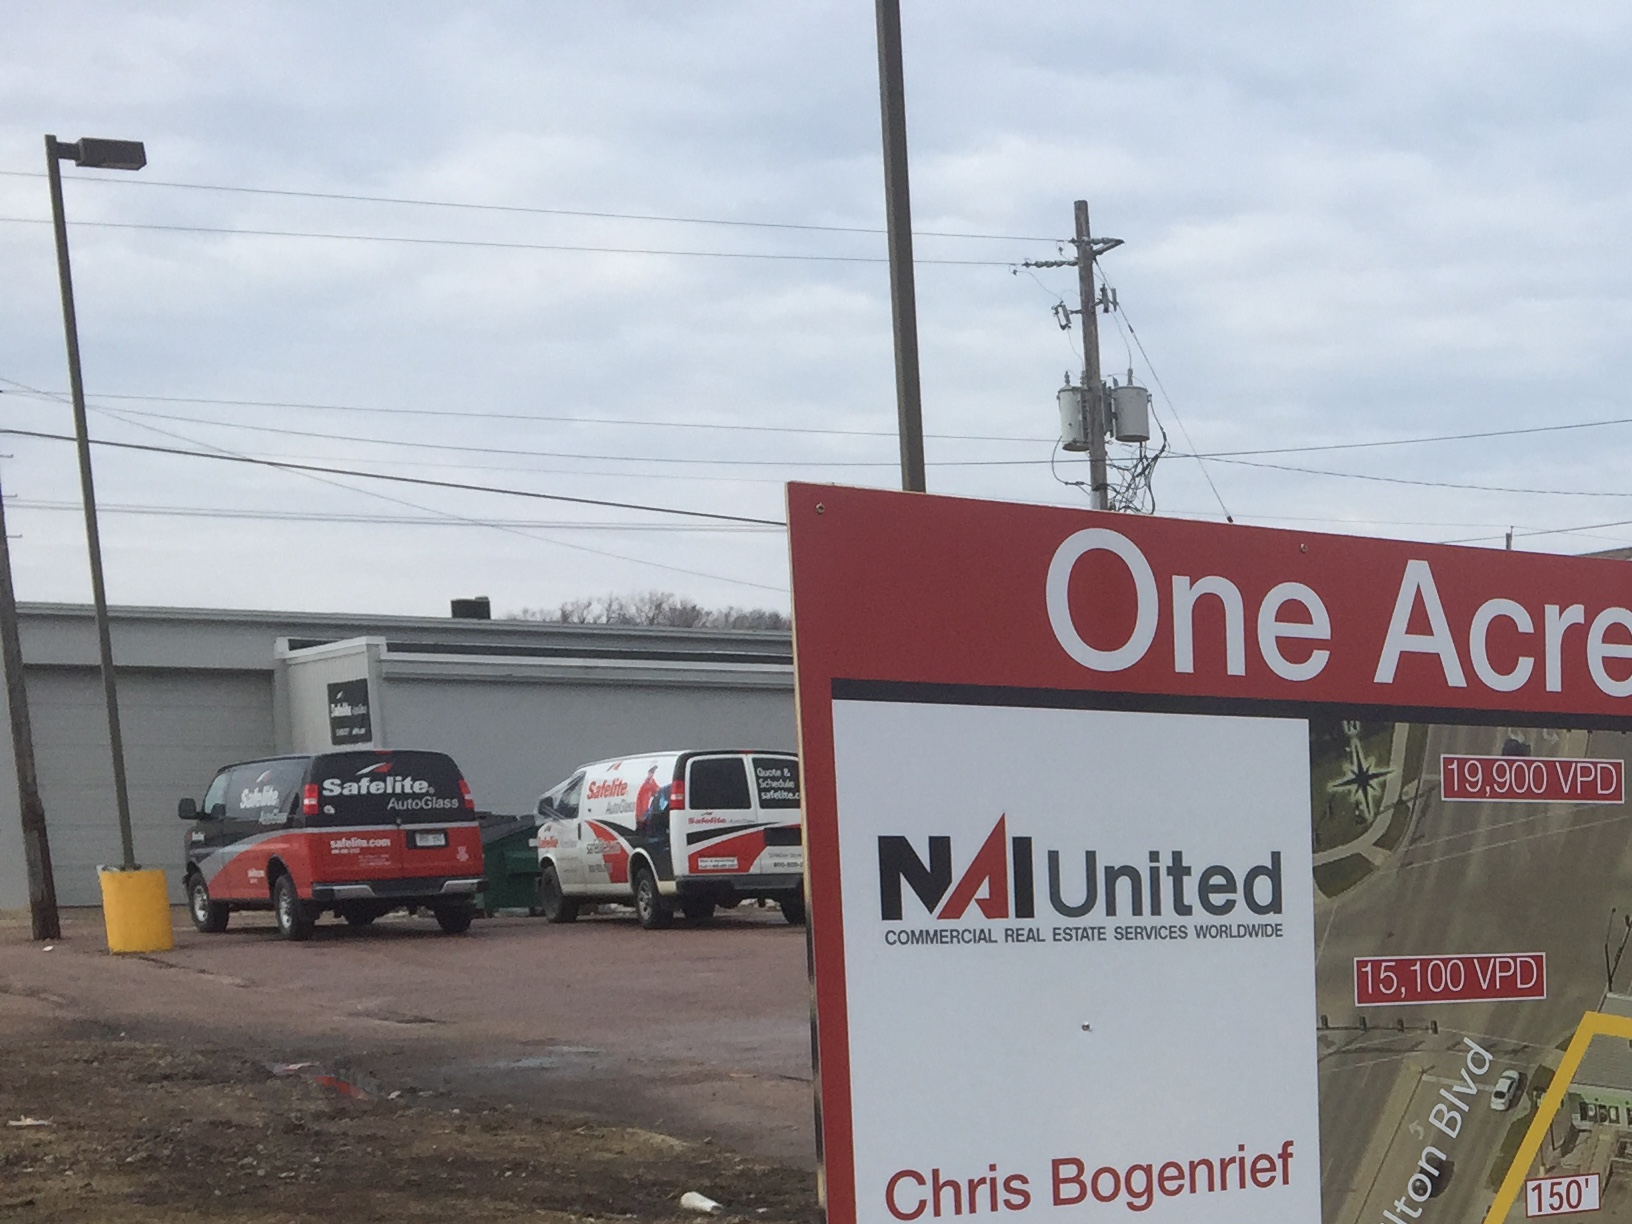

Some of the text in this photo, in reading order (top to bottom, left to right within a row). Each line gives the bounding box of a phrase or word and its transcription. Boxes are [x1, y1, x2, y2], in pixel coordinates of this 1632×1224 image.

[1045, 527, 1332, 681] One
[586, 778, 628, 800] Safelite
[757, 767, 791, 777] Quote &
[759, 778, 795, 788] Schedule
[1448, 759, 1618, 799] 19,900 VPD
[387, 796, 459, 811] AutoGlass
[330, 837, 391, 849] safelite.com
[877, 812, 1283, 921] NAI United
[885, 923, 1283, 945] COMMERCIAL REAL ESTATE SERVICES WORLDWIDE
[1360, 957, 1538, 1000] 15,100 VPD
[1428, 1038, 1493, 1138] Blvd
[884, 1140, 1294, 1221] Chris Bogenrief
[1530, 1178, 1589, 1213] 150'
